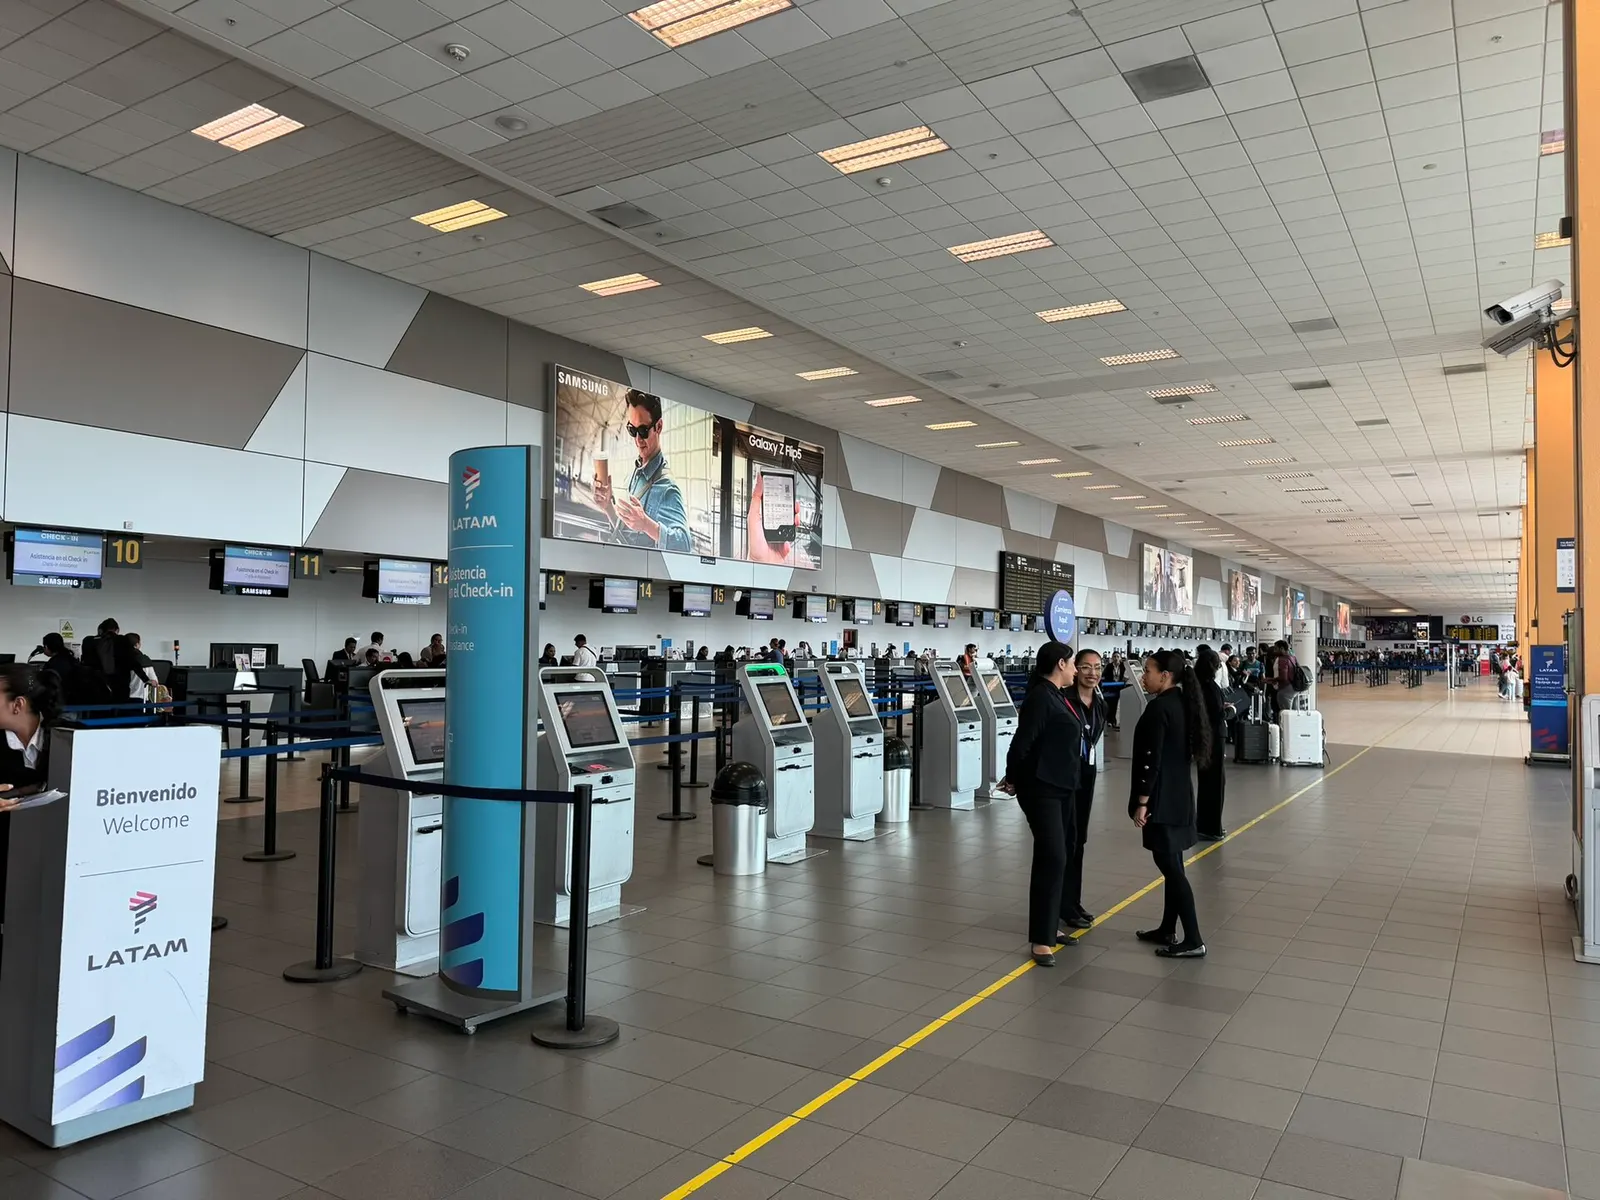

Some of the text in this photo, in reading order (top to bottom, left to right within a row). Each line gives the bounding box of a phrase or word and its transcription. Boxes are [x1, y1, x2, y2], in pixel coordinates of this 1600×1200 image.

[558, 371, 608, 396] SAMSUNG
[749, 434, 802, 461] Galaxy Z Flip5
[452, 515, 497, 531] LATAM
[112, 539, 139, 564] 10
[300, 554, 319, 575] 11
[39, 577, 79, 586] SAMSUNG
[551, 575, 564, 592] 13
[242, 587, 271, 595] SAMSUNG
[460, 582, 513, 598] Check-in
[640, 582, 652, 598] 14
[714, 588, 724, 602] 15
[776, 593, 785, 607] 16
[829, 598, 836, 611] 17
[96, 782, 197, 807] Bienvenido
[103, 814, 190, 835] Welcome
[87, 938, 188, 971] LATAM
